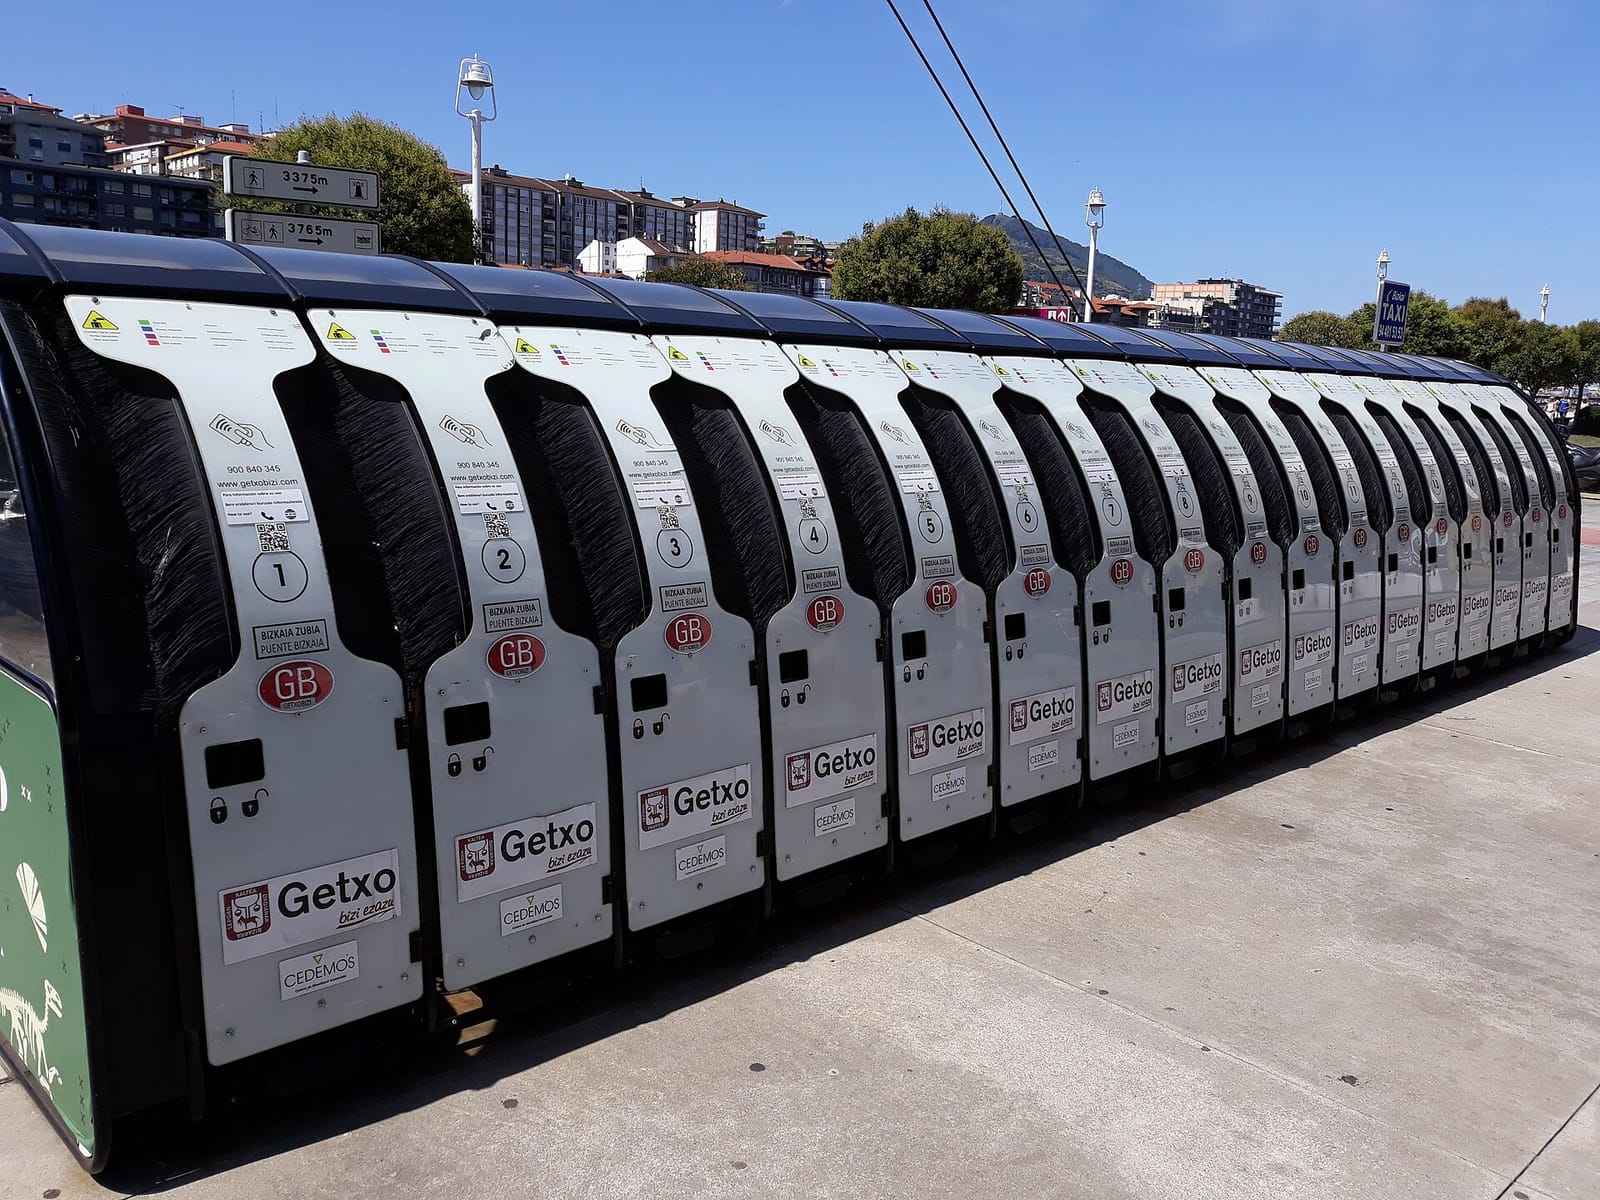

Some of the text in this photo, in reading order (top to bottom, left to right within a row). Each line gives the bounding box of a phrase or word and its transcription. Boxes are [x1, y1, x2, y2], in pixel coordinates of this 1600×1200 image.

[282, 170, 328, 186] 3375m
[287, 222, 333, 237] 3765m
[1383, 303, 1405, 322] TAXI
[227, 464, 281, 474] 900 840 345
[457, 460, 500, 469] 900 840 345
[216, 478, 299, 489] www.getxobizi.com
[449, 474, 515, 482] www.getxobizi.com
[1182, 496, 1189, 510] 8
[1247, 493, 1253, 506] 9
[1300, 489, 1308, 501] 10
[1024, 509, 1032, 524] 6
[1108, 503, 1114, 518] 7
[810, 526, 819, 543] 4
[926, 518, 935, 534] 5
[670, 537, 681, 557] 3
[1253, 544, 1264, 560] GB
[1306, 537, 1317, 552] GB
[496, 548, 512, 570] 2
[1188, 551, 1201, 569] GB
[273, 563, 285, 588] 1
[1115, 561, 1129, 580] GB
[1029, 571, 1046, 591] GB
[665, 586, 702, 597] BIZKAIA ZUBIA
[932, 585, 951, 606] GB
[1502, 590, 1518, 602] Getxo
[490, 603, 536, 617] BIZKAIA ZUBIA
[665, 600, 685, 609] PUENTE
[815, 600, 836, 623] GB
[1436, 601, 1456, 618] Getxo
[1471, 597, 1489, 611] Getxo
[490, 615, 539, 629] PUENTE BIZKAIA
[1397, 613, 1419, 629] Getxo
[261, 625, 321, 640] BIZKAIA ZUBIA
[675, 618, 702, 644] GB
[1353, 623, 1377, 640] Getxo
[261, 638, 325, 655] PUENTE BIZKAIA
[1305, 635, 1332, 653] Getxo
[500, 639, 533, 668] GB
[1253, 647, 1281, 668] Getxo
[1187, 662, 1221, 684] Getxo
[274, 666, 318, 700] GB
[1114, 680, 1153, 703] Getxo
[1029, 697, 1074, 722] Getxo
[932, 720, 984, 749] Getxo
[814, 747, 876, 778] Getxo
[933, 777, 965, 793] CEDEMOS
[674, 778, 749, 816] Getxo
[816, 809, 854, 828] CEDEMOS
[500, 819, 594, 862] Getxo
[548, 846, 592, 869] bizi ezazu
[678, 848, 724, 871] CEDEMOS
[277, 868, 397, 918] Getxo
[339, 898, 395, 924] bizi ezazu
[503, 898, 560, 925] CEDEMOS
[284, 956, 356, 988] CEDEMOS
